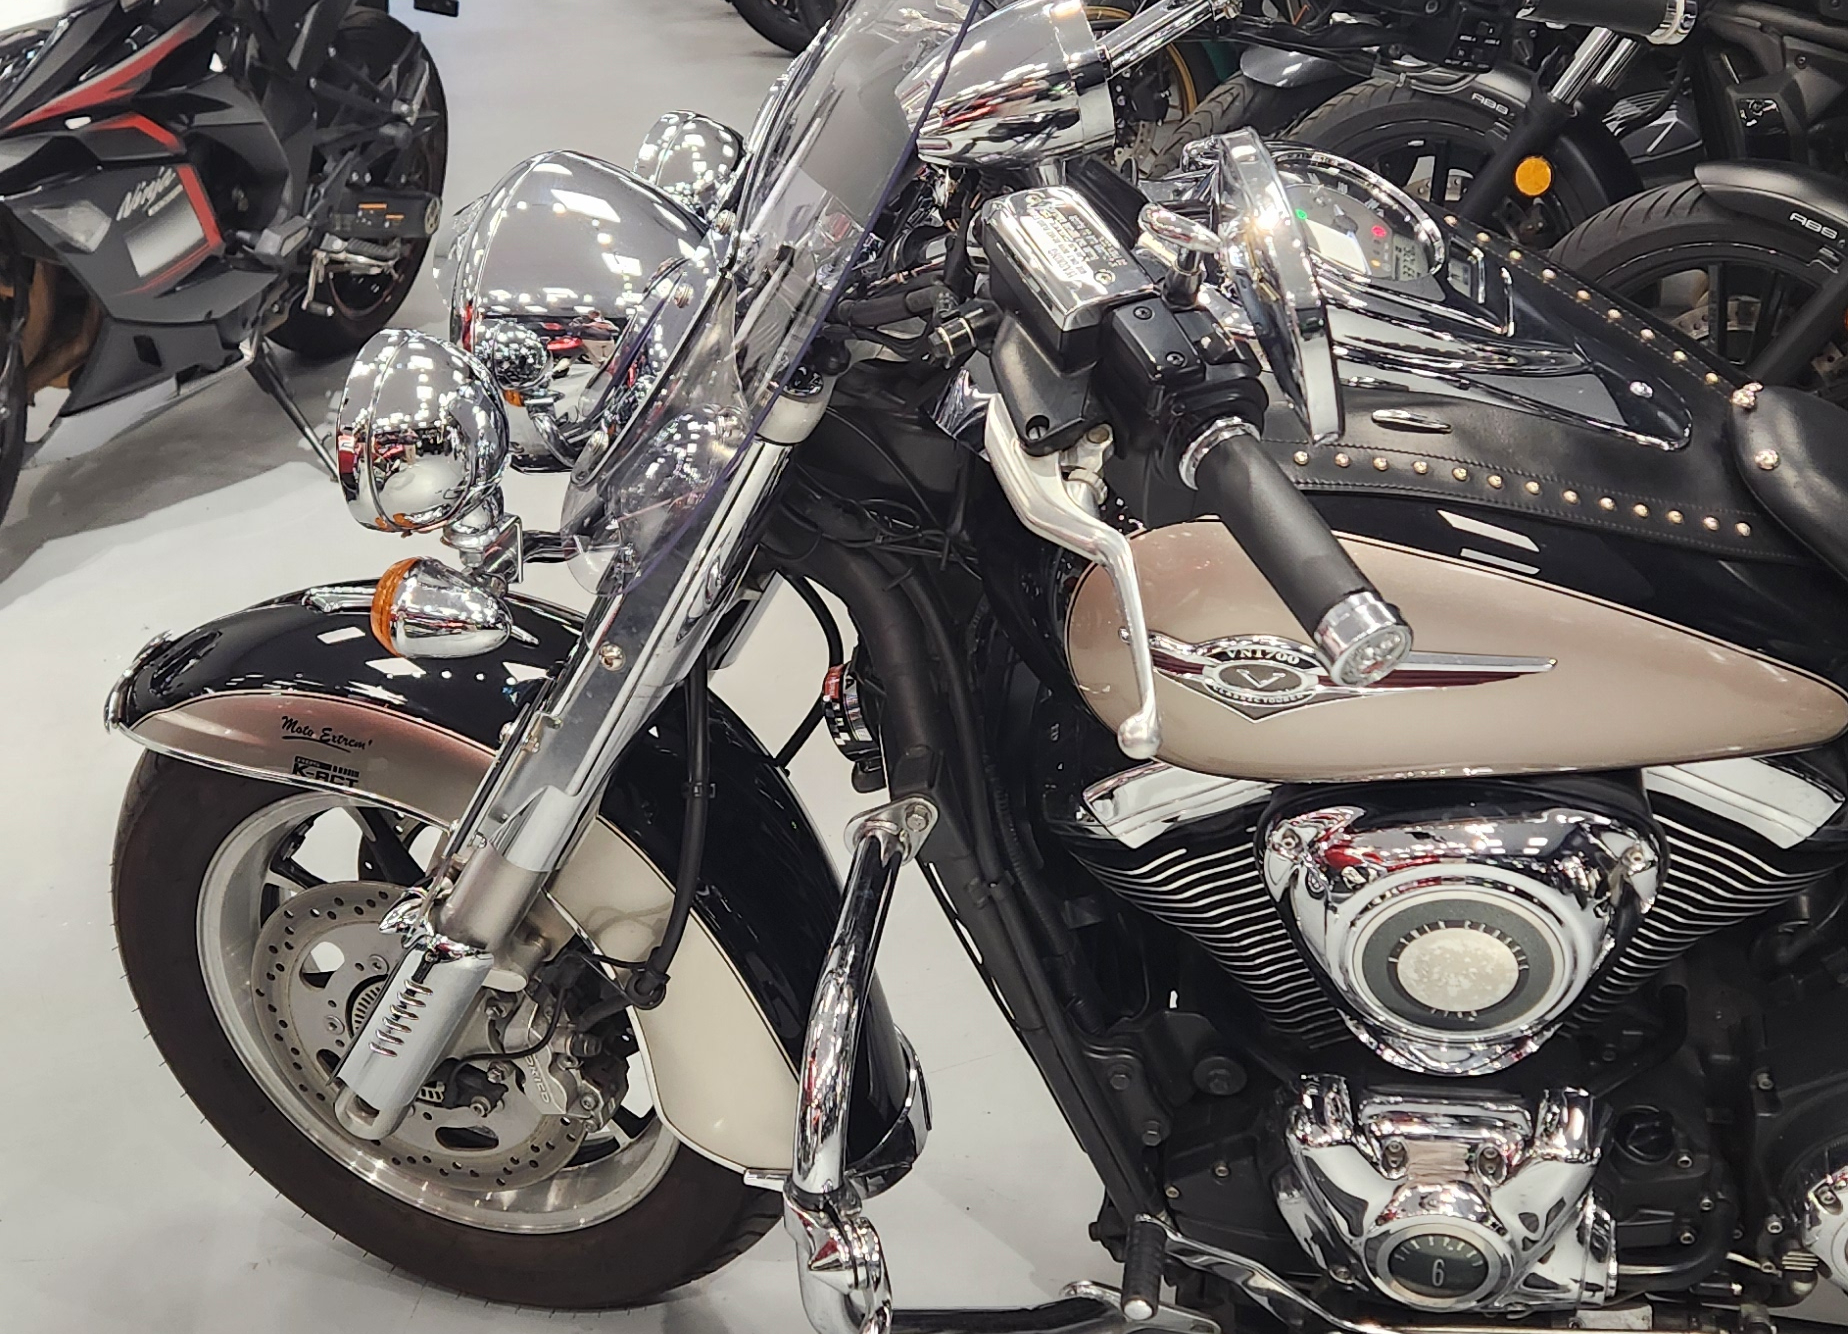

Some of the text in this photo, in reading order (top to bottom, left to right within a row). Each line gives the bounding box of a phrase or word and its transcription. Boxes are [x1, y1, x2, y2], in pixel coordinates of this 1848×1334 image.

[1789, 212, 1838, 239] ABS
[1226, 648, 1300, 665] VN1700
[282, 716, 315, 736] Moto
[292, 763, 359, 788] K-ACT
[525, 1055, 550, 1103] OKICO
